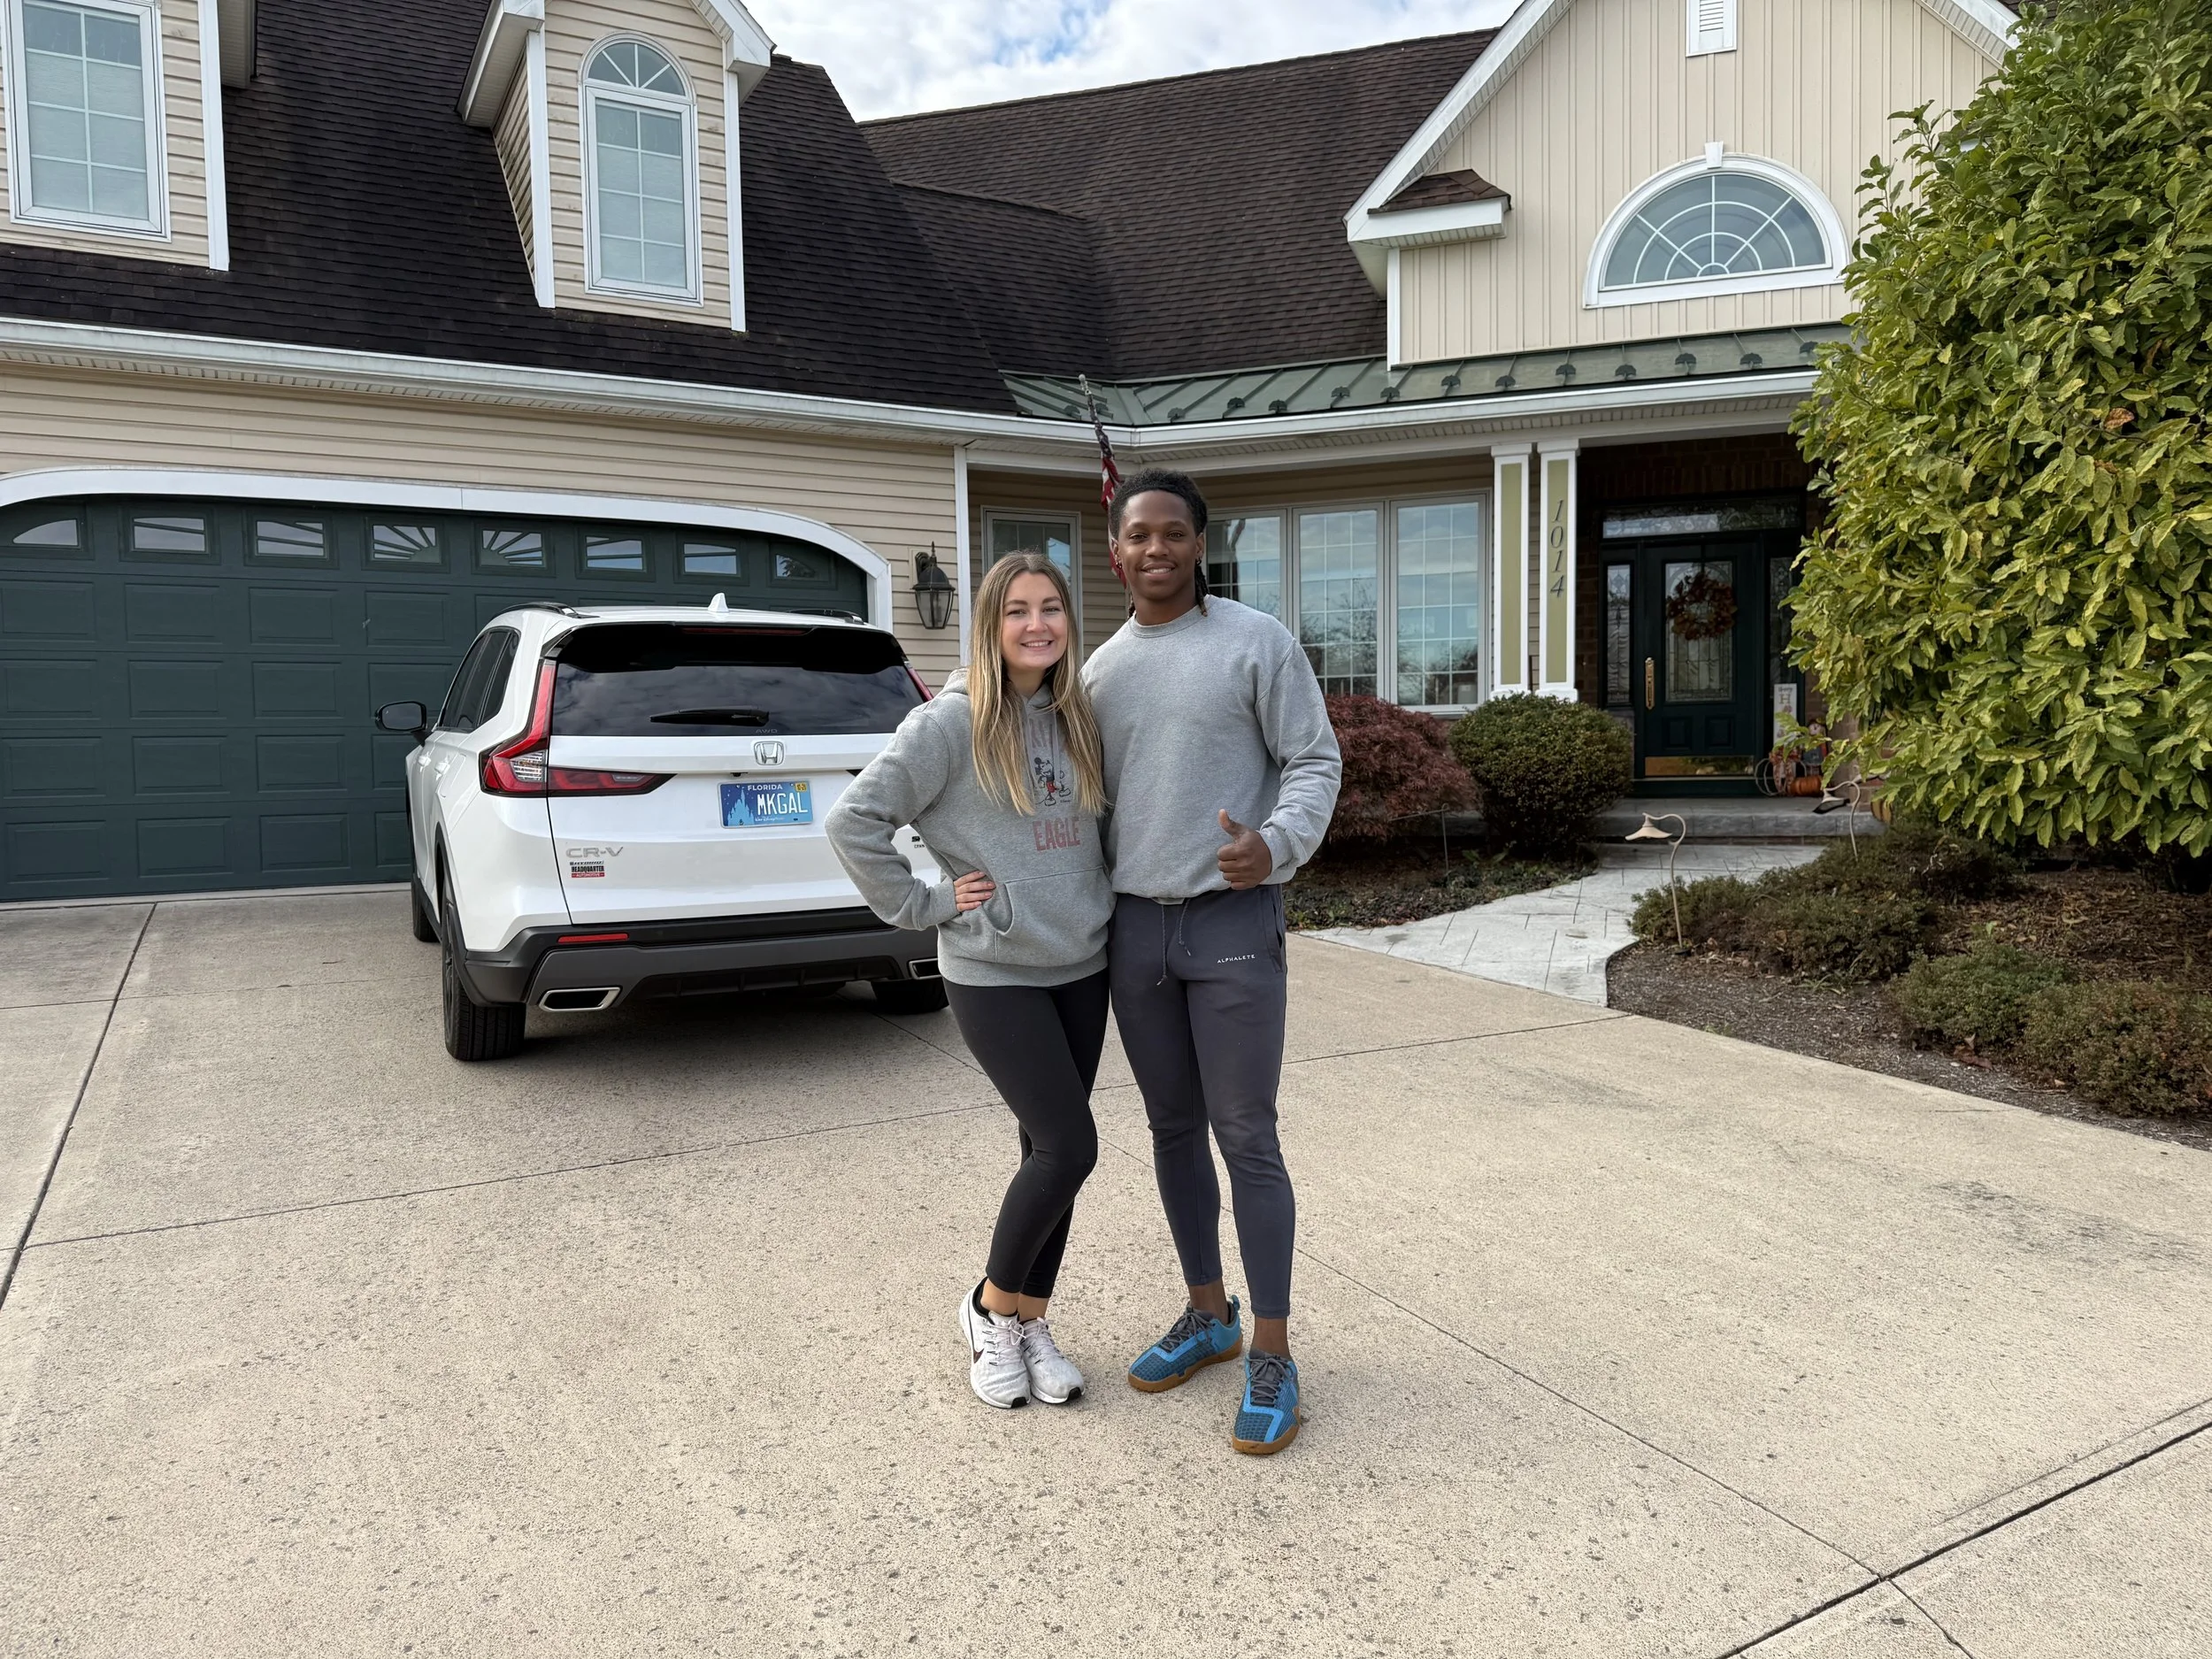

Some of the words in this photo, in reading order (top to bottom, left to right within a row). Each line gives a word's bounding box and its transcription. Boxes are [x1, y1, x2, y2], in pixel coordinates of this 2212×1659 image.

[1549, 499, 1564, 598] 1014
[757, 792, 809, 816] MKGAL
[1032, 815, 1080, 852] EAGLE
[566, 846, 624, 858] CR-V
[1217, 954, 1256, 964] ALPHALETE
